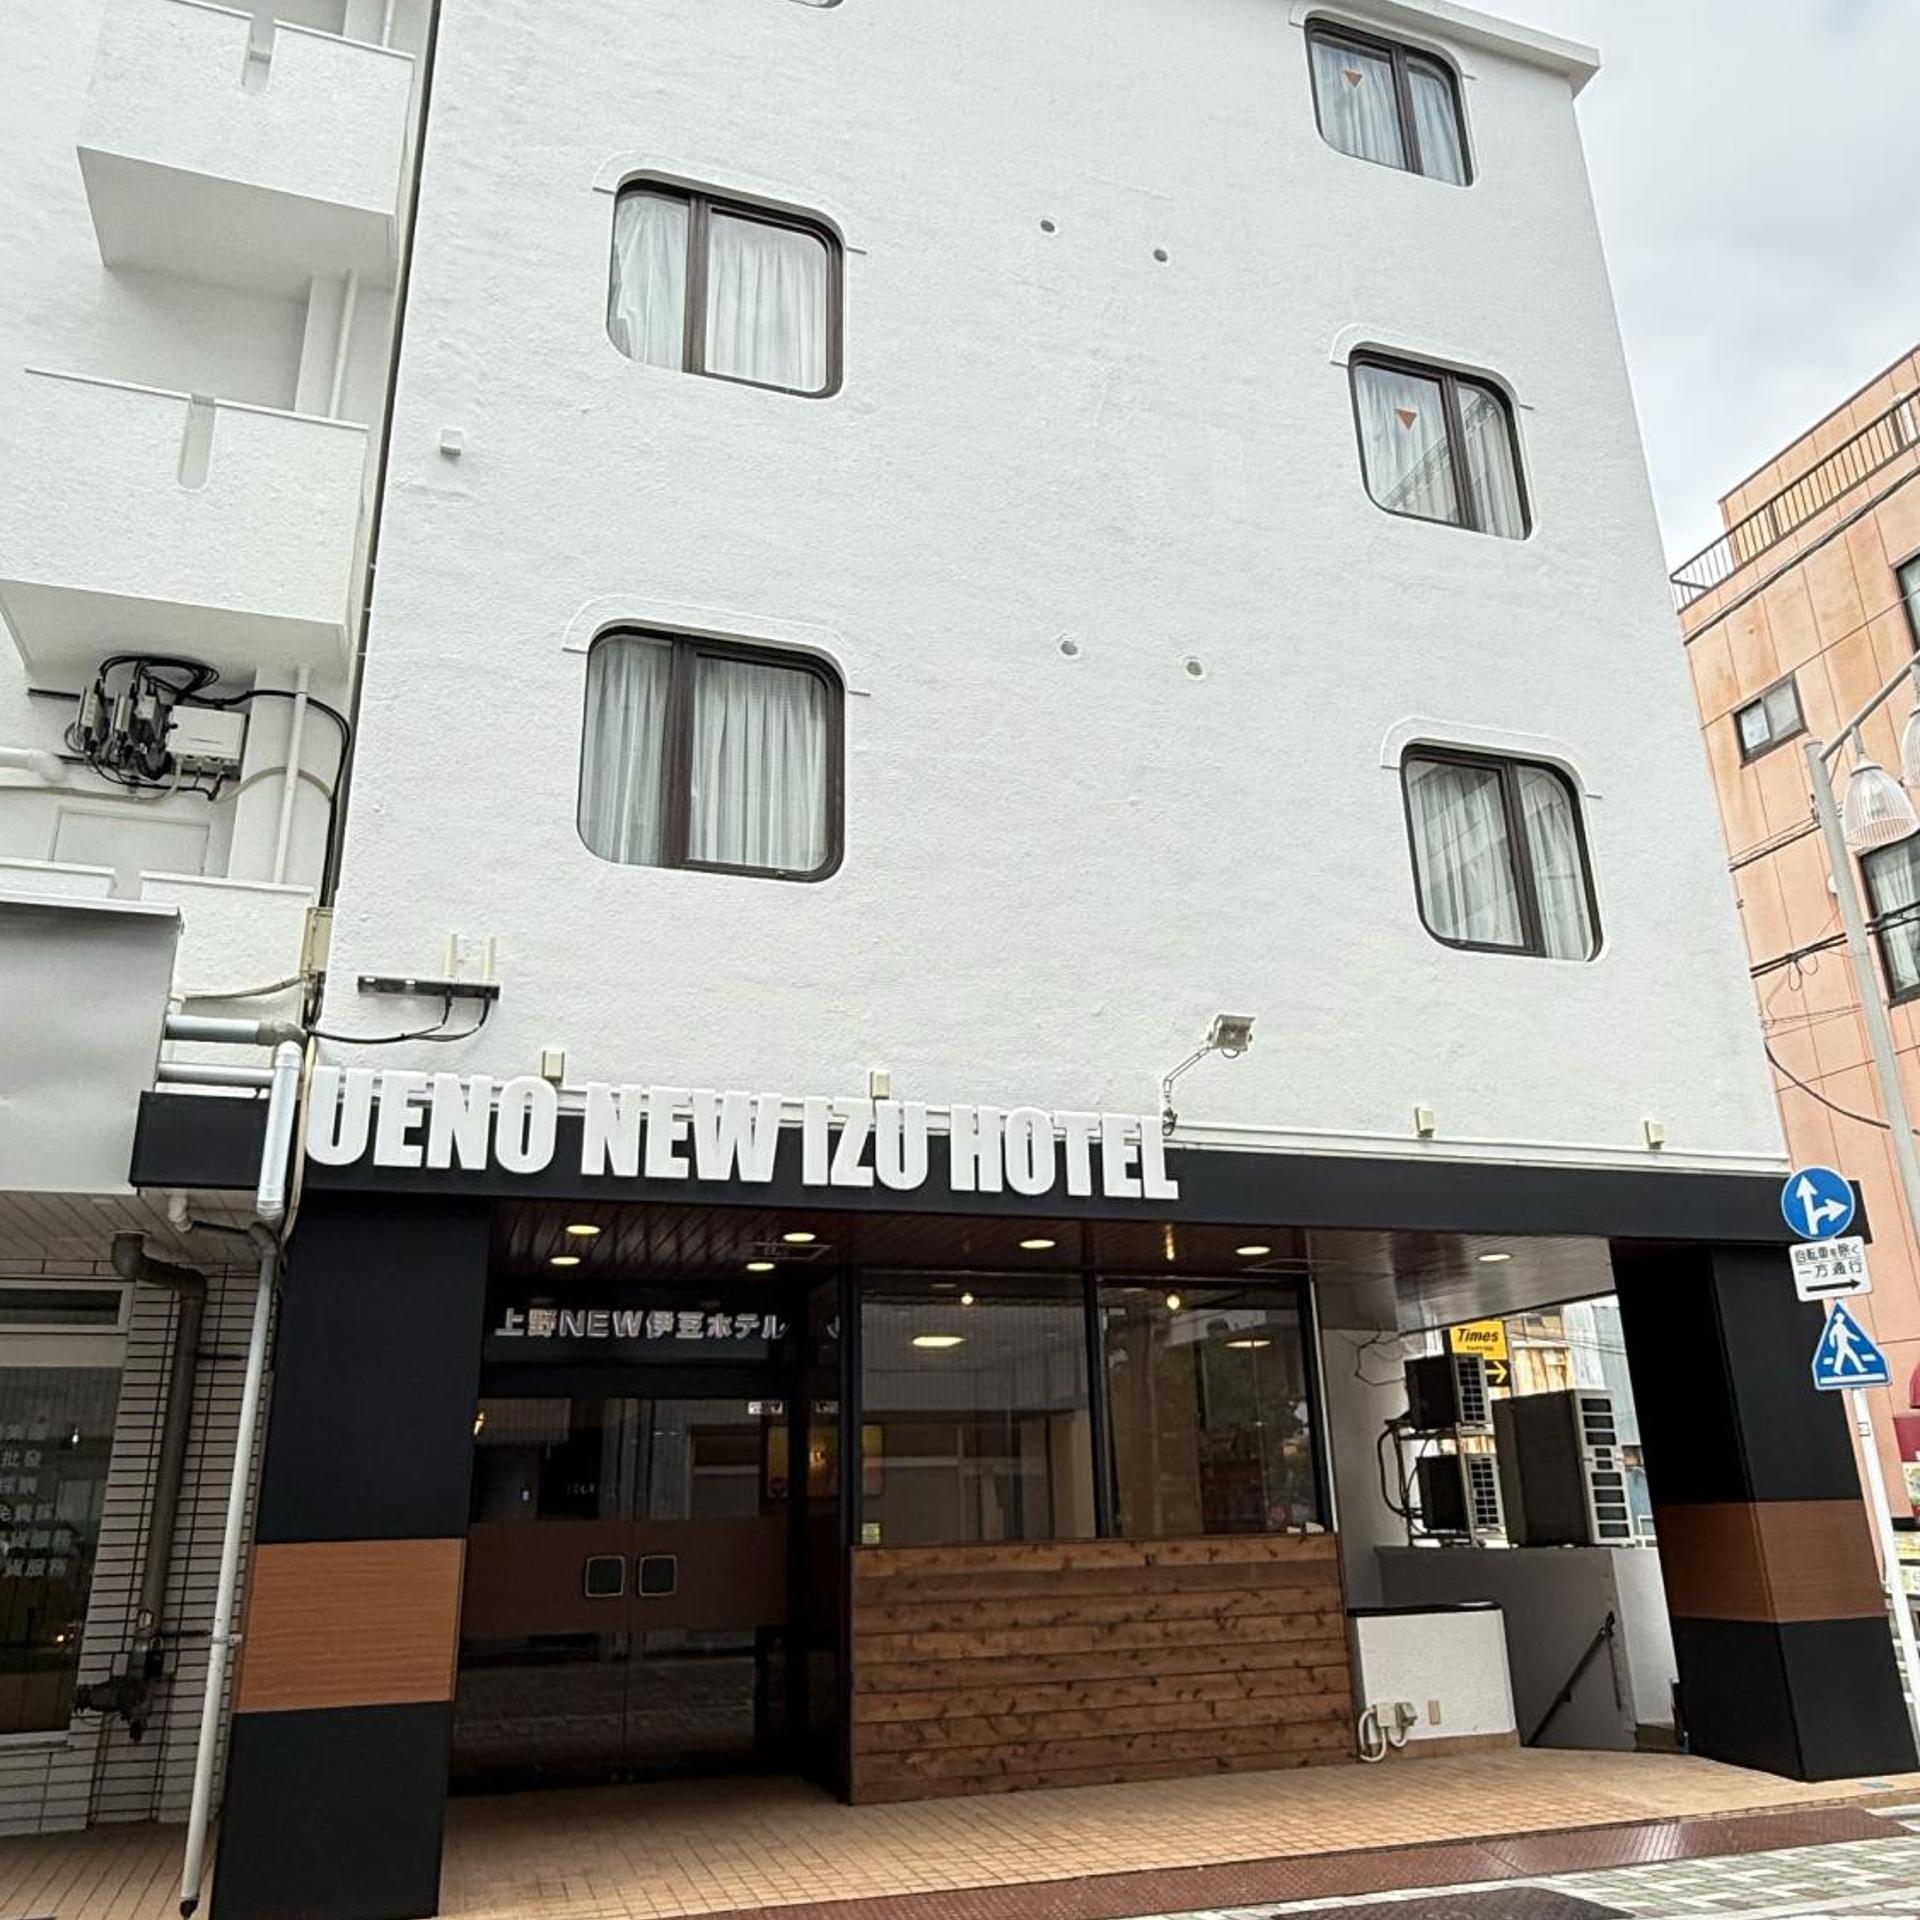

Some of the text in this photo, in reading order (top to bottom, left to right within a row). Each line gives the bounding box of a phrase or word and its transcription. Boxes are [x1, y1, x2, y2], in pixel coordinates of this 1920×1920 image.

[305, 1065, 1179, 1199] UENO NEW IZU HOTEL
[1795, 1243, 1860, 1262] 自転車を除く
[1799, 1260, 1862, 1277] 一方通行
[494, 1307, 787, 1339] 上野NEW伊豆ホテル
[1457, 1328, 1499, 1342] Times
